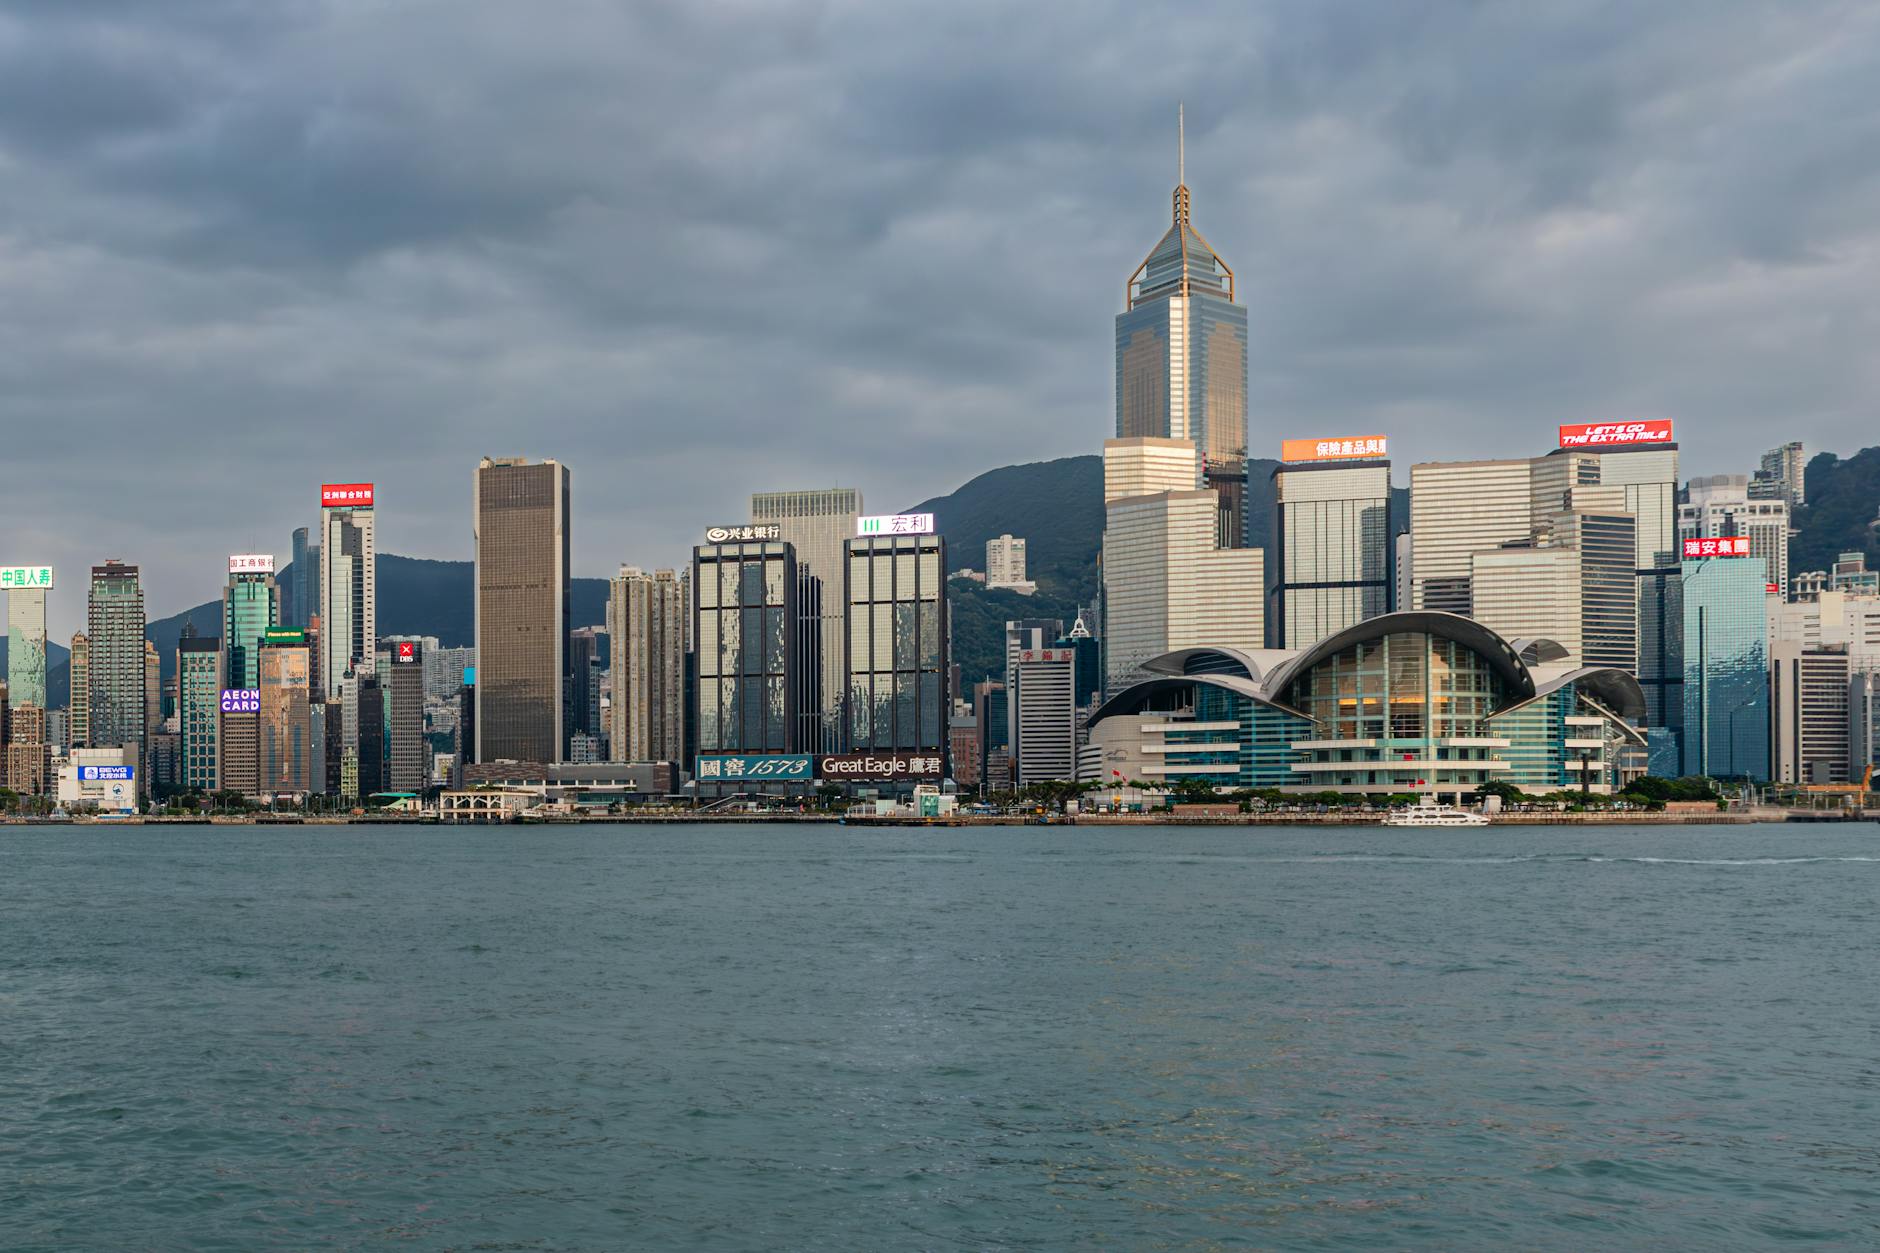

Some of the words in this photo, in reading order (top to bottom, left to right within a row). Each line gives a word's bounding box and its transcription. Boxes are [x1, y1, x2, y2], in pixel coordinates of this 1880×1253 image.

[1585, 424, 1625, 435] LET'S
[1626, 423, 1646, 433] GO
[1563, 435, 1589, 444] THE
[1590, 432, 1635, 442] EXTRA
[1636, 430, 1668, 440] MILE
[891, 515, 927, 532] 宏利
[729, 526, 779, 540] 兴业银行
[2, 569, 50, 586] 中国人寿
[222, 690, 260, 700] AEON
[222, 701, 260, 711] CARD
[737, 759, 808, 775] 1573
[822, 757, 863, 773] Great
[865, 756, 906, 776] Eagle
[908, 757, 941, 774] 鷹君
